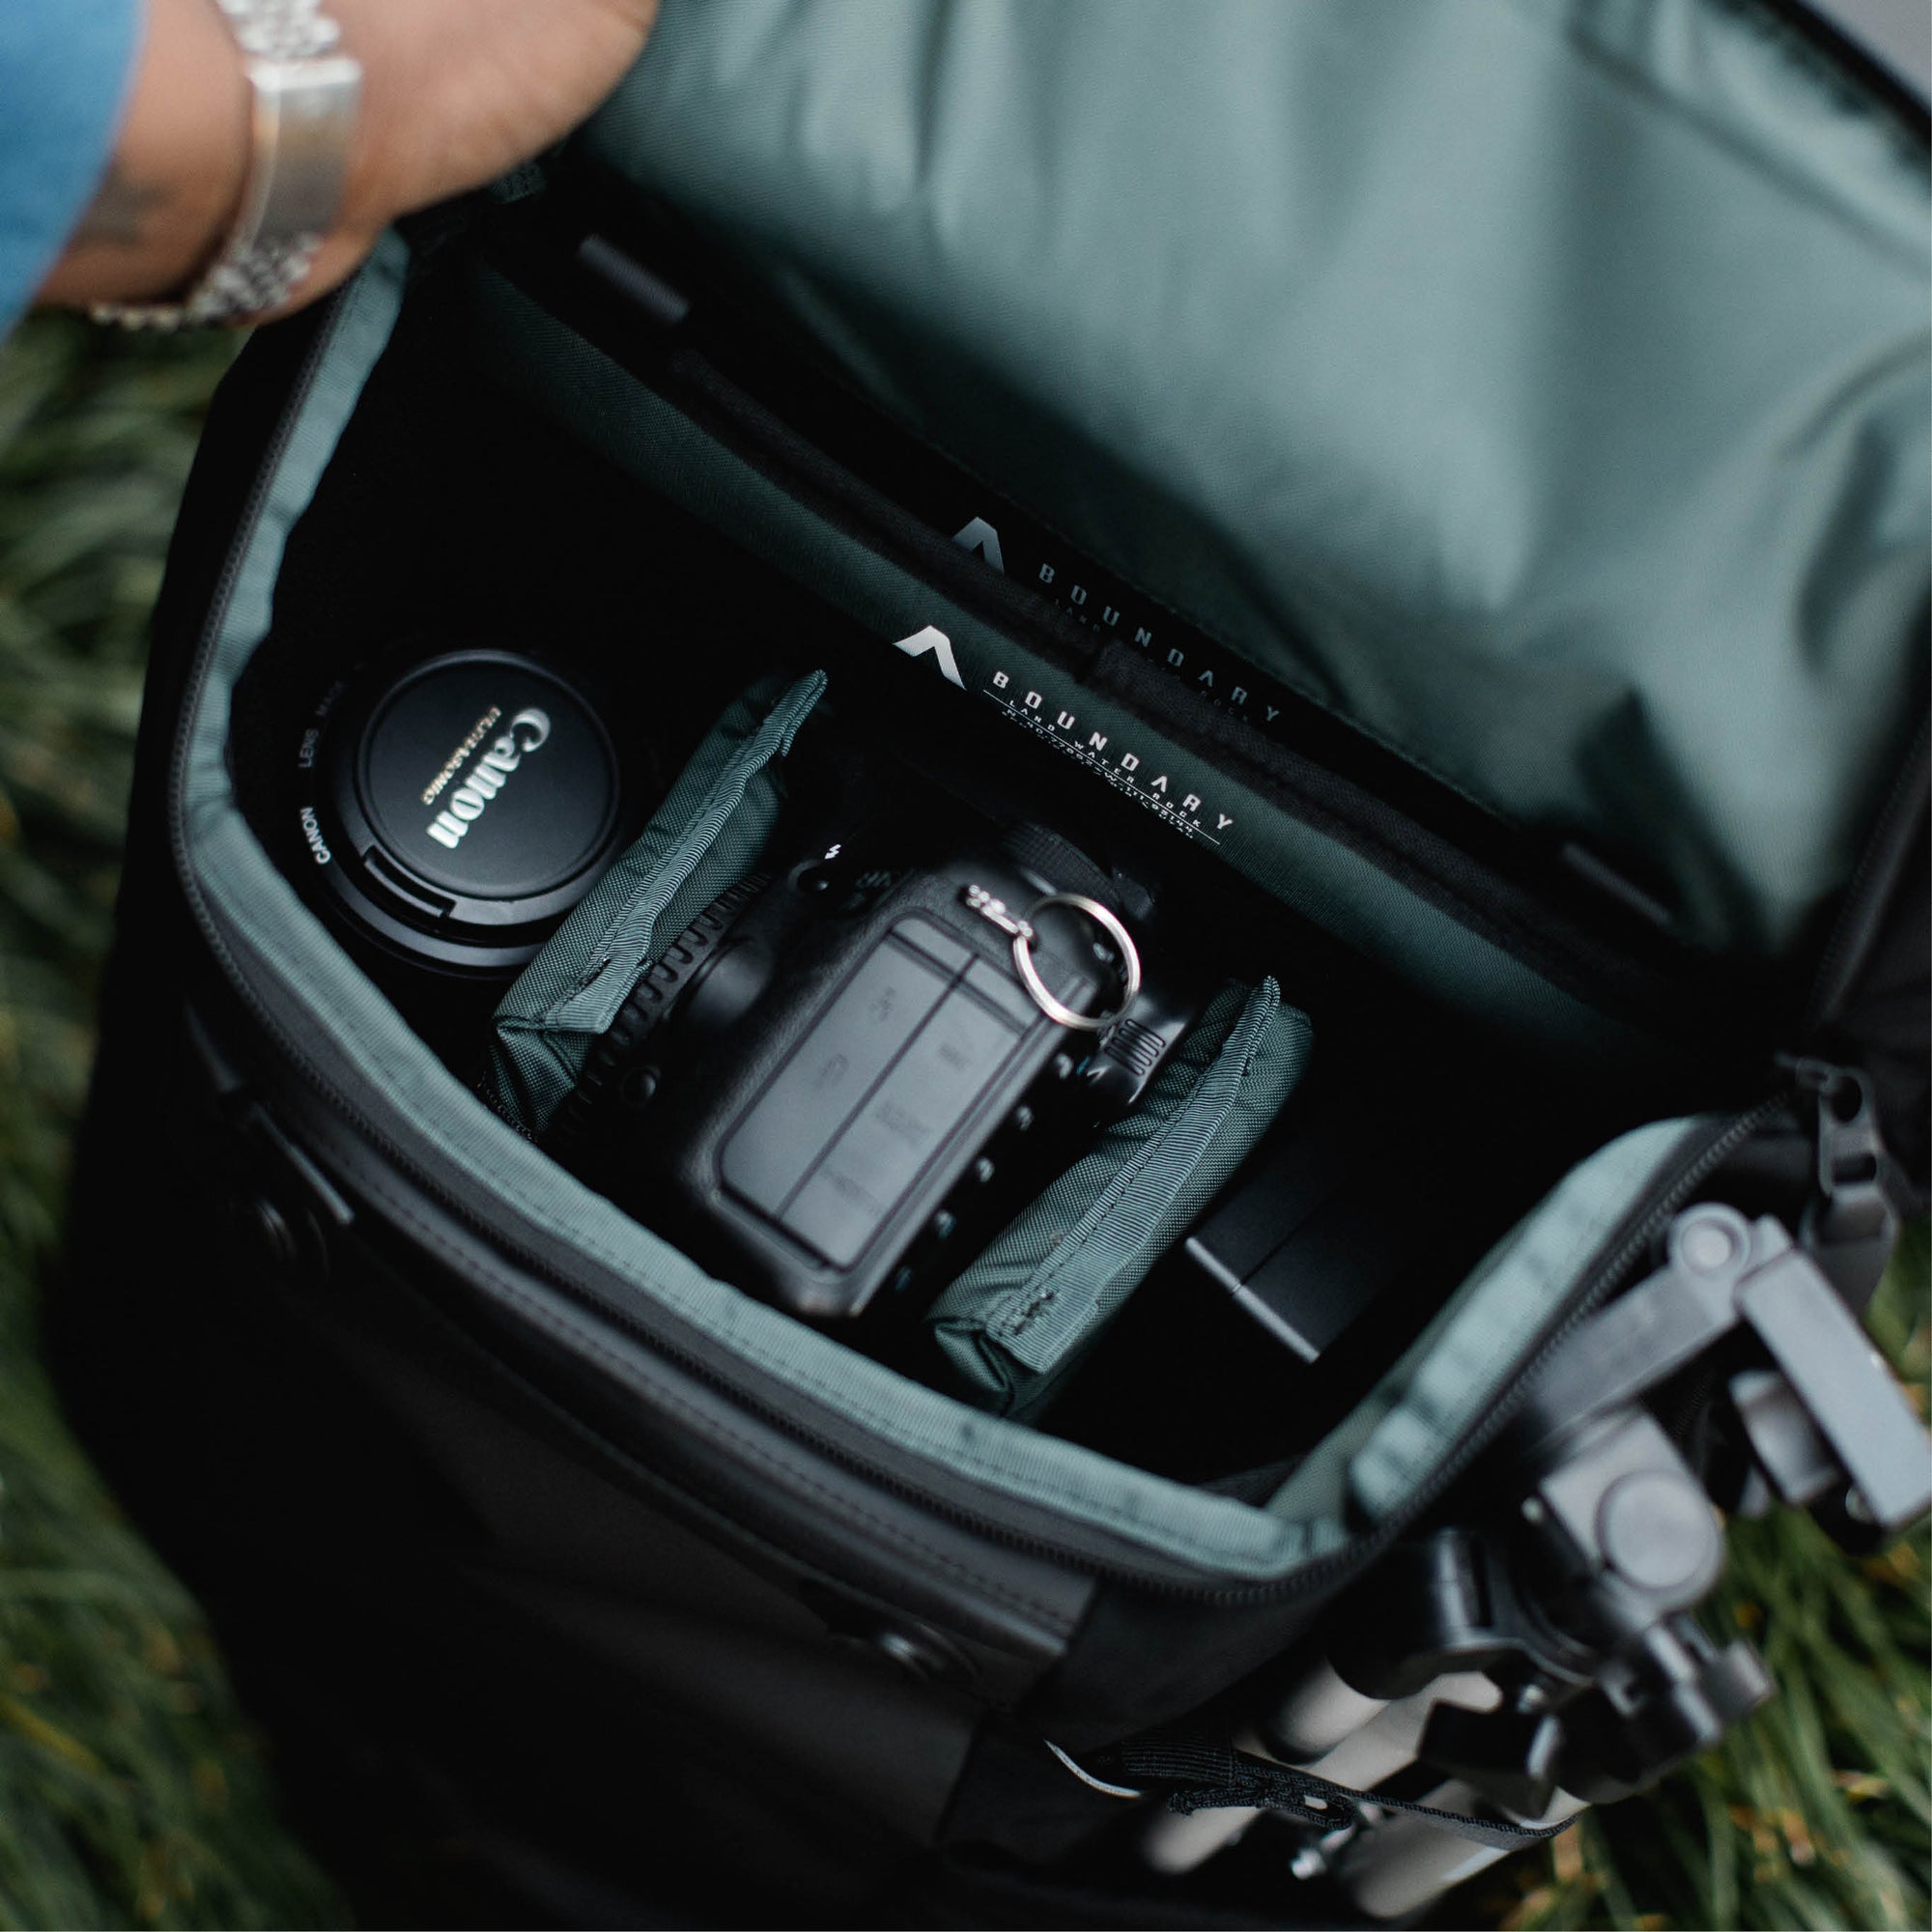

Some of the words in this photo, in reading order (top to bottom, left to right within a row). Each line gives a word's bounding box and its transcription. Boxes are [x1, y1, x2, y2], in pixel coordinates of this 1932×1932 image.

[1038, 563, 1280, 723] BOUNDARY
[298, 728, 320, 769] LENS
[427, 708, 551, 849] Canon
[992, 671, 1233, 830] BOUNDARY
[1009, 699, 1056, 732] LAND
[1074, 741, 1135, 784] WATER
[1151, 792, 1202, 827] ROCK
[299, 806, 332, 865] CANON
